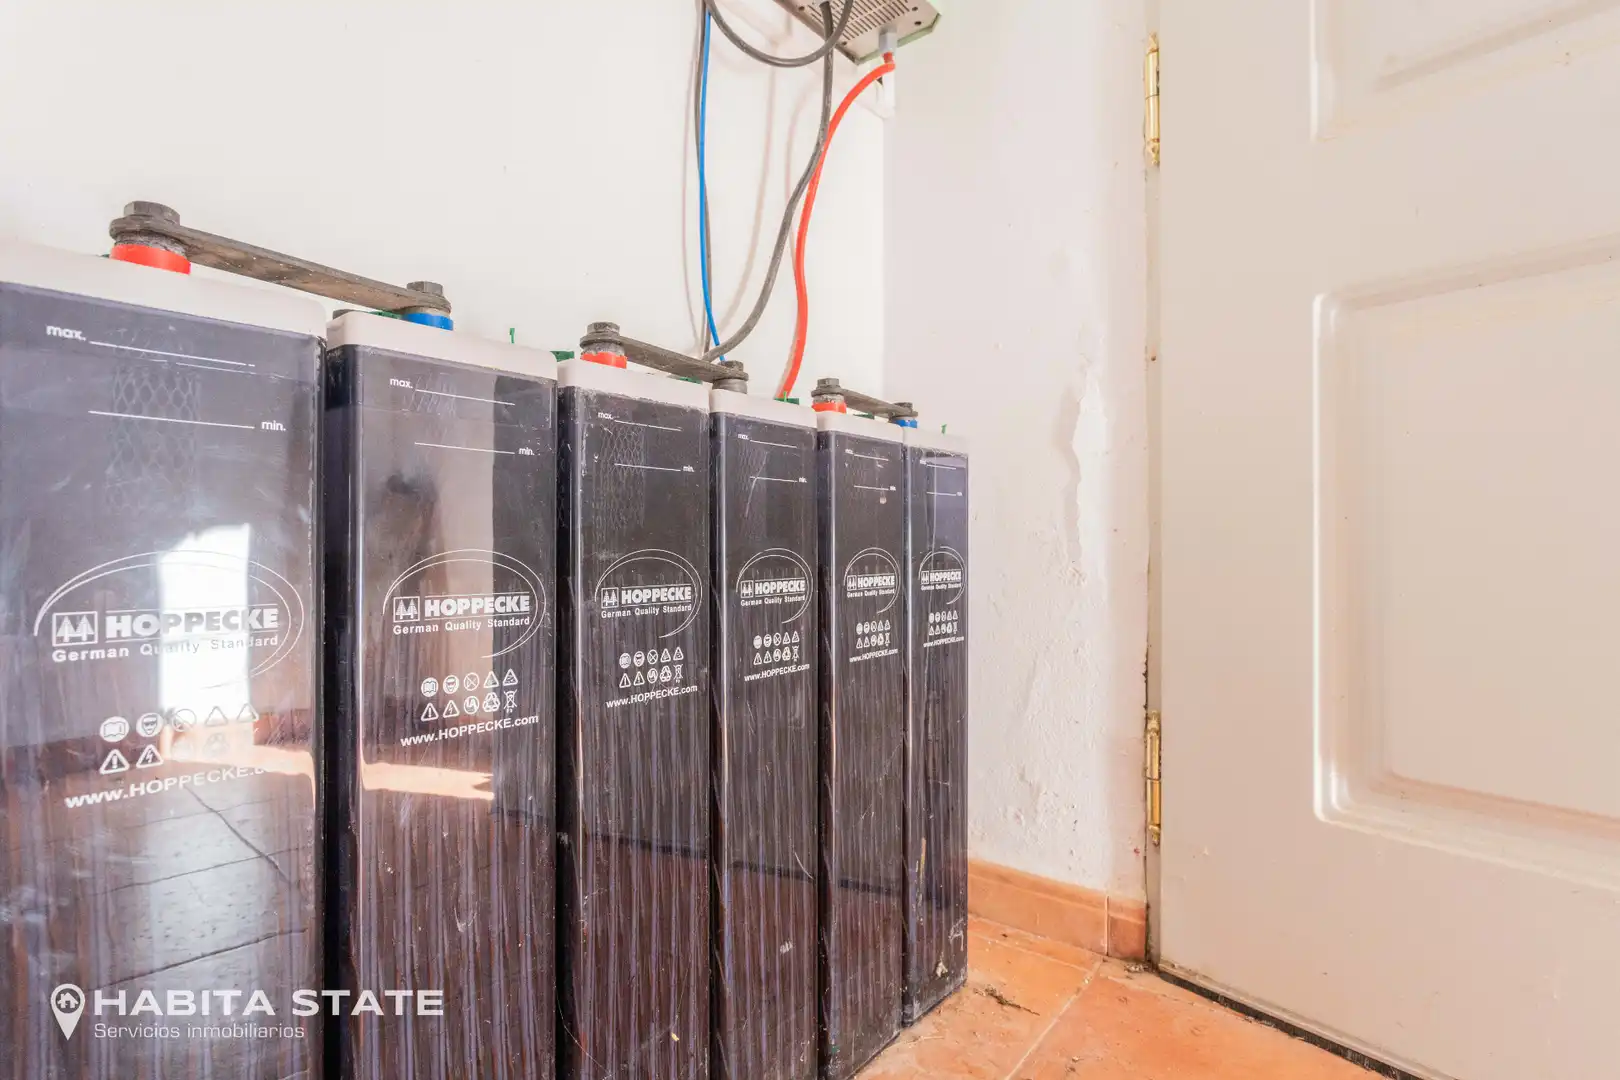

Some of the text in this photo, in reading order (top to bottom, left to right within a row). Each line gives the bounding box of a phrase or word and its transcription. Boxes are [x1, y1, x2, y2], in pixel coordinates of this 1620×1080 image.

[46, 324, 87, 341] max.
[389, 377, 413, 389] max.
[597, 411, 614, 420] max.
[261, 418, 287, 431] min.
[518, 447, 535, 456] min.
[754, 580, 806, 595] HOPPECKE
[857, 575, 895, 588] HOPPECKE
[621, 586, 692, 605] HOPPECKE
[740, 599, 762, 607] German
[784, 594, 806, 602] Standard
[424, 595, 530, 618] HOPPECKE
[601, 604, 692, 618] German Quality Standard
[105, 608, 279, 639] HOPPECKE
[393, 616, 530, 635] German Quality Standard
[52, 646, 129, 663] German
[849, 648, 898, 663] www.HOPPECKE.com
[744, 663, 810, 682] www.HOPPECKE.com
[606, 685, 698, 708] www.HOPPECKE.com
[400, 714, 539, 747] www.HOPPECKE.com
